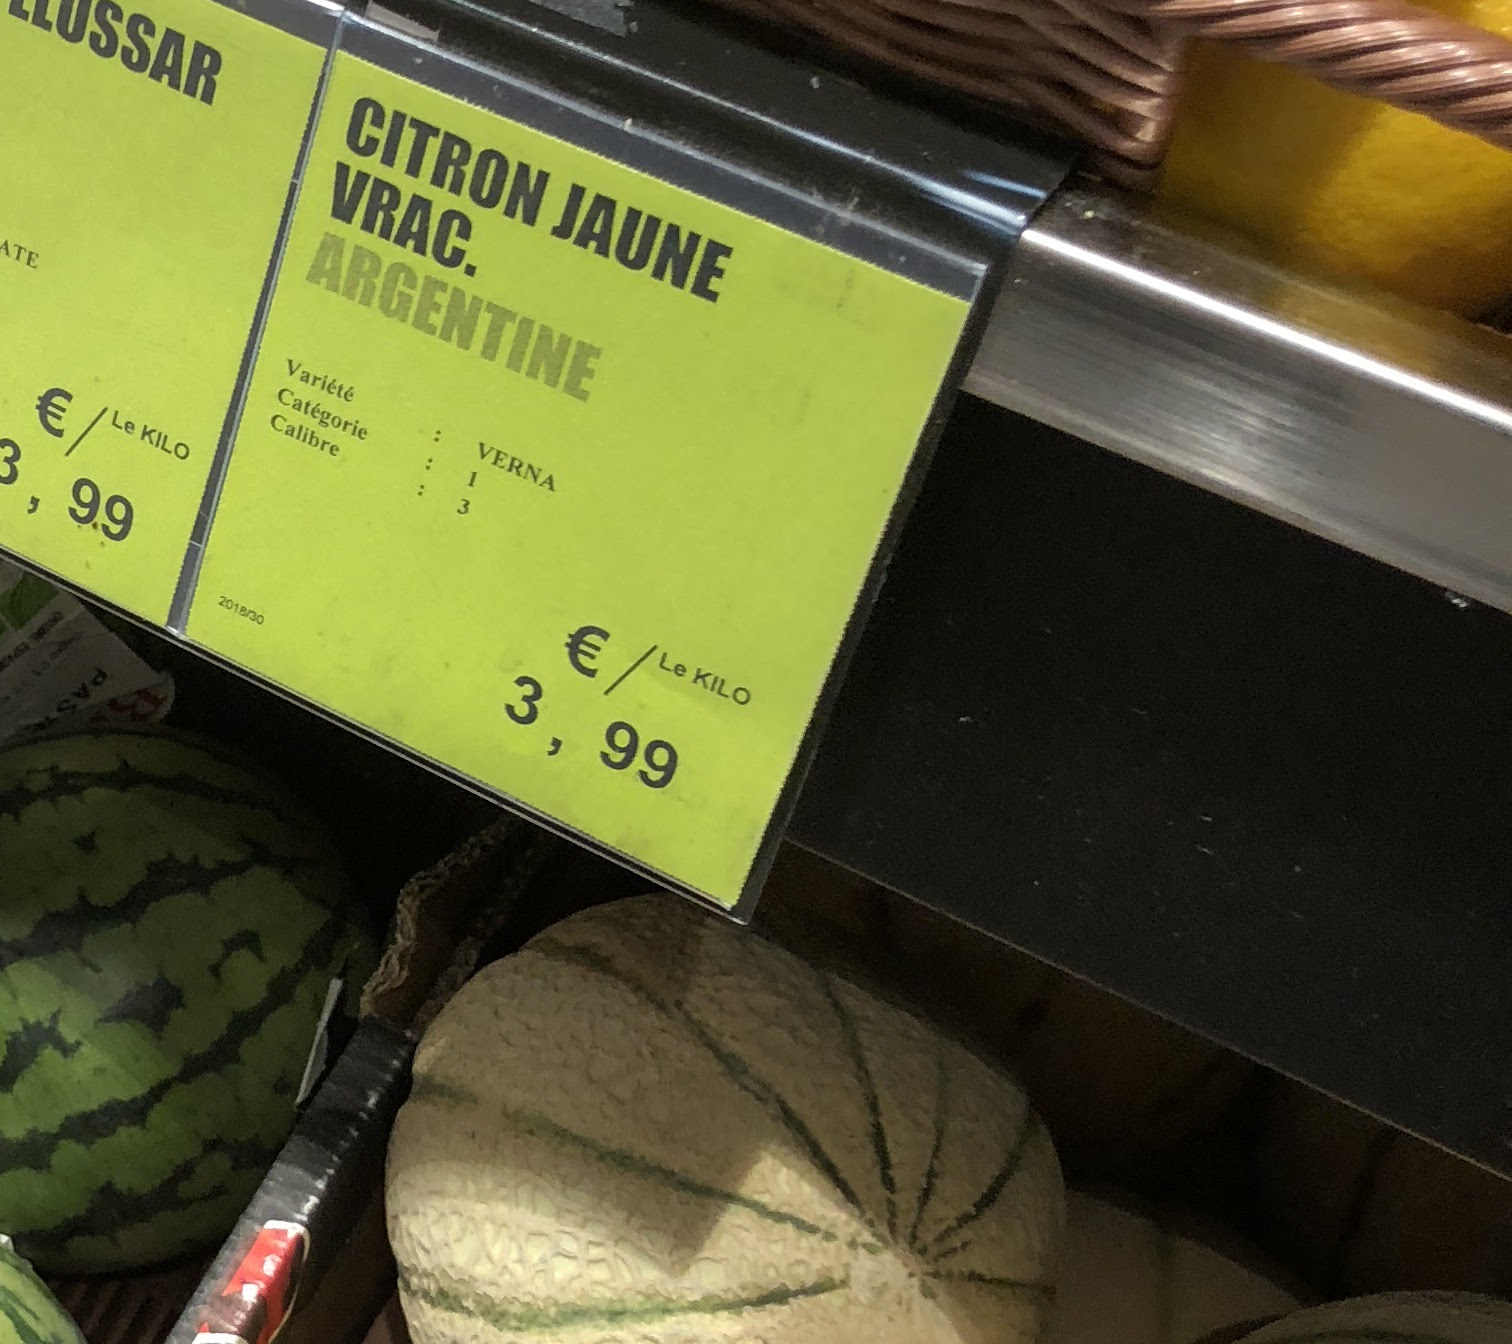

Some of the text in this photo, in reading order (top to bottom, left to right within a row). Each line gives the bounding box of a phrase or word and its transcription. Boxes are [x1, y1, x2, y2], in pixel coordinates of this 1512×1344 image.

[331, 162, 477, 277] VRAC.
[346, 97, 734, 303] CITRON JAUNE
[306, 233, 603, 403] ARGENTINE
[35, 388, 74, 438] €
[140, 424, 190, 460] KILO
[270, 415, 340, 457] Calibre
[456, 499, 471, 515] 3
[277, 388, 368, 441] Catégorie
[467, 472, 478, 488] 1
[286, 359, 355, 403] Variété
[478, 442, 556, 493] VERNA
[217, 595, 265, 626] 2018/30
[564, 625, 610, 678] €
[693, 668, 752, 706] KILO
